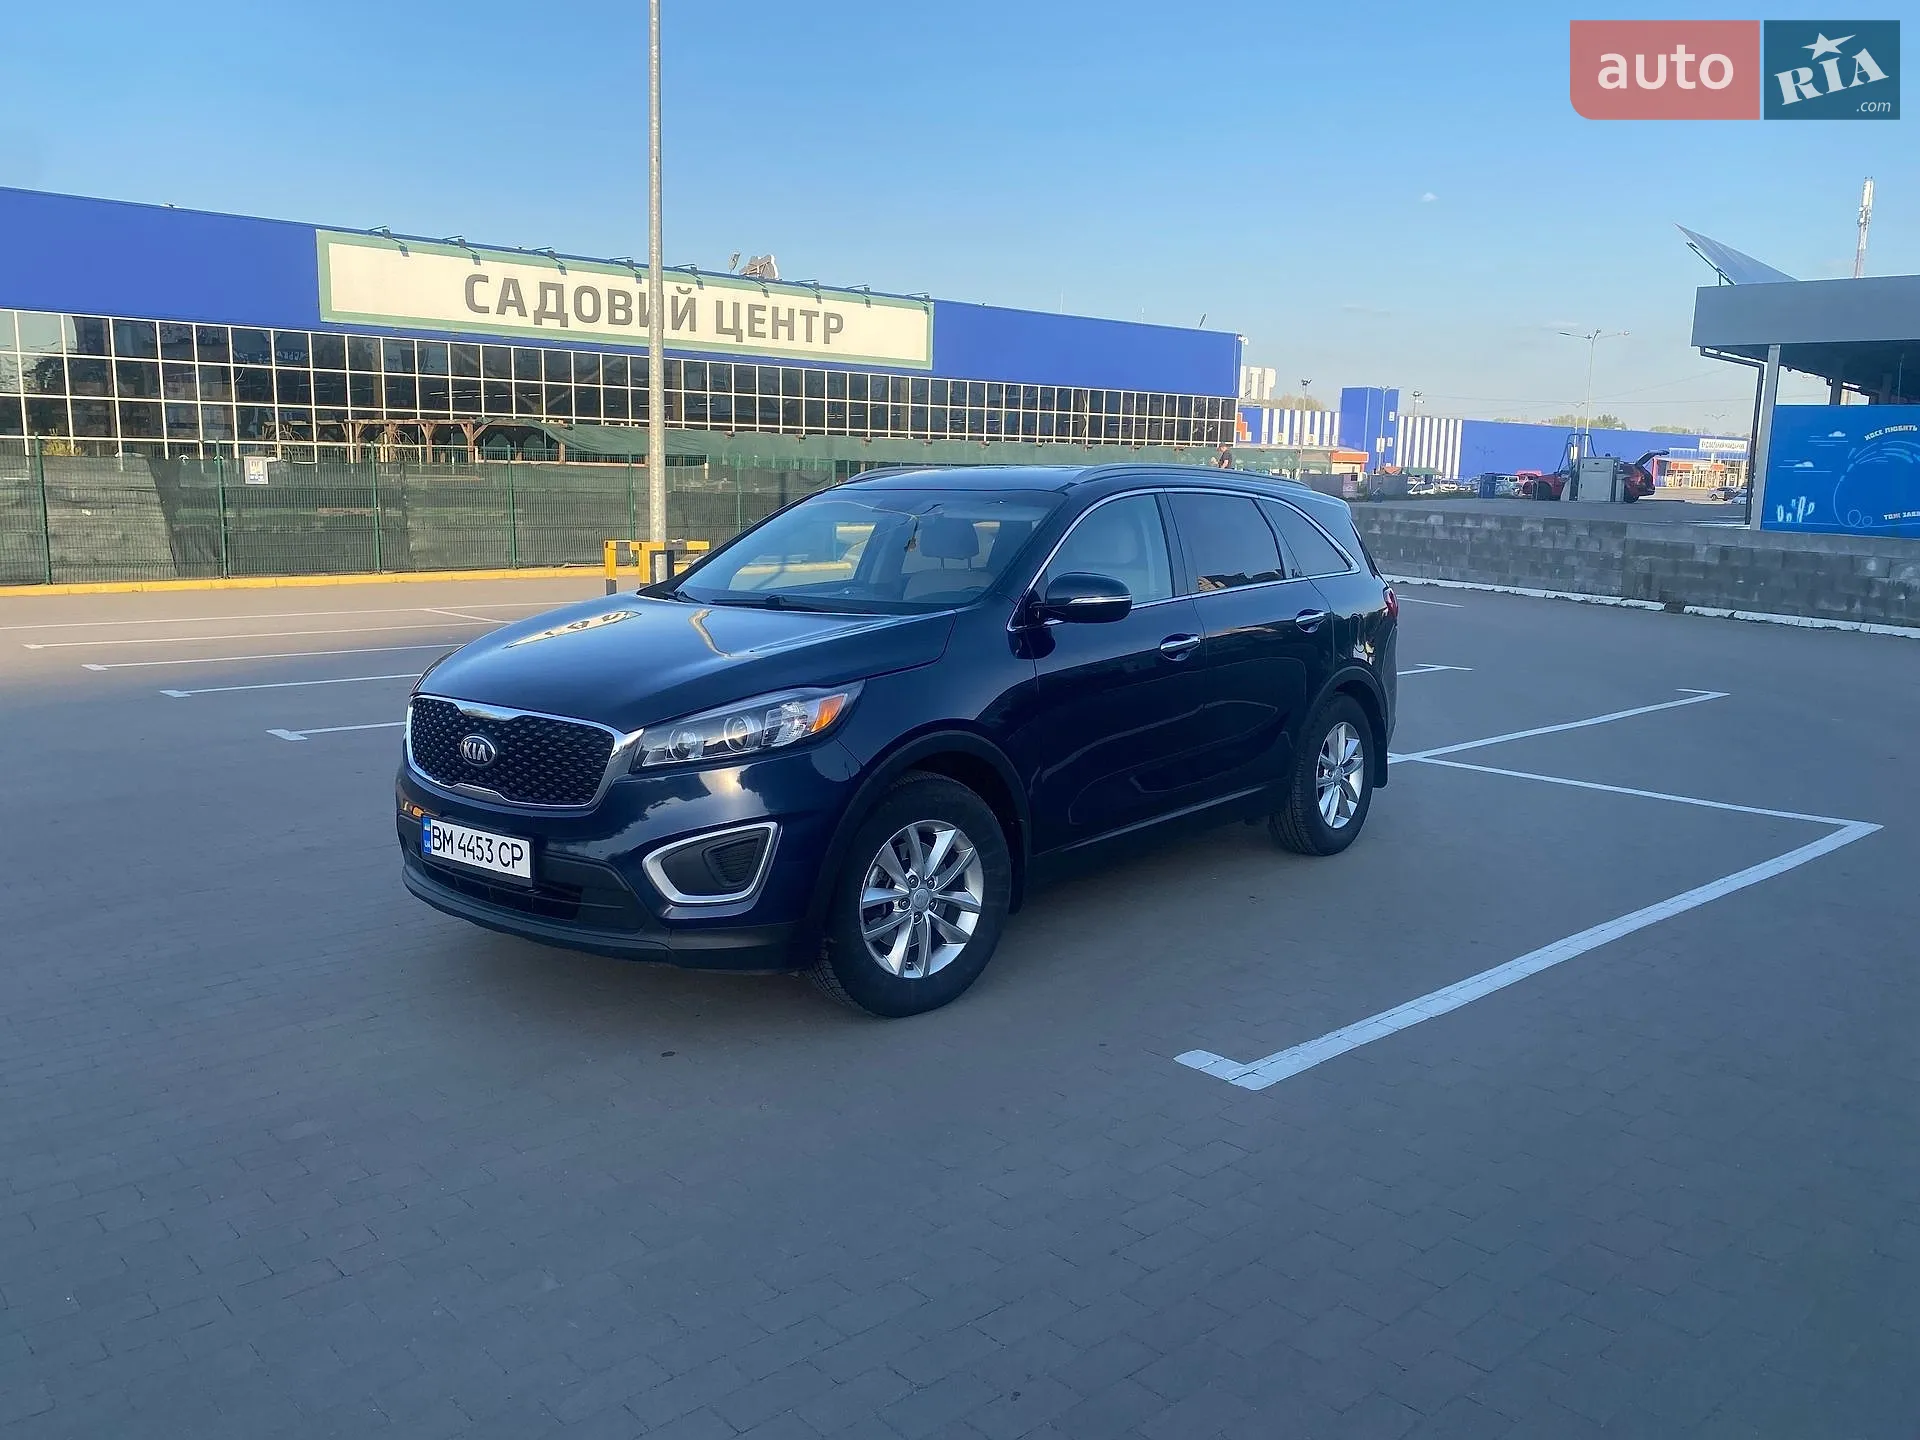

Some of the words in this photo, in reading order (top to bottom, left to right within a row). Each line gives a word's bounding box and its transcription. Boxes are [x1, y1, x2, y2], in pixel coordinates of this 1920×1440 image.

[715, 300, 844, 344] ЦЕНТР
[463, 741, 488, 762] KIA
[432, 825, 454, 854] BM
[458, 832, 494, 864] 4453
[499, 841, 524, 869] CP
